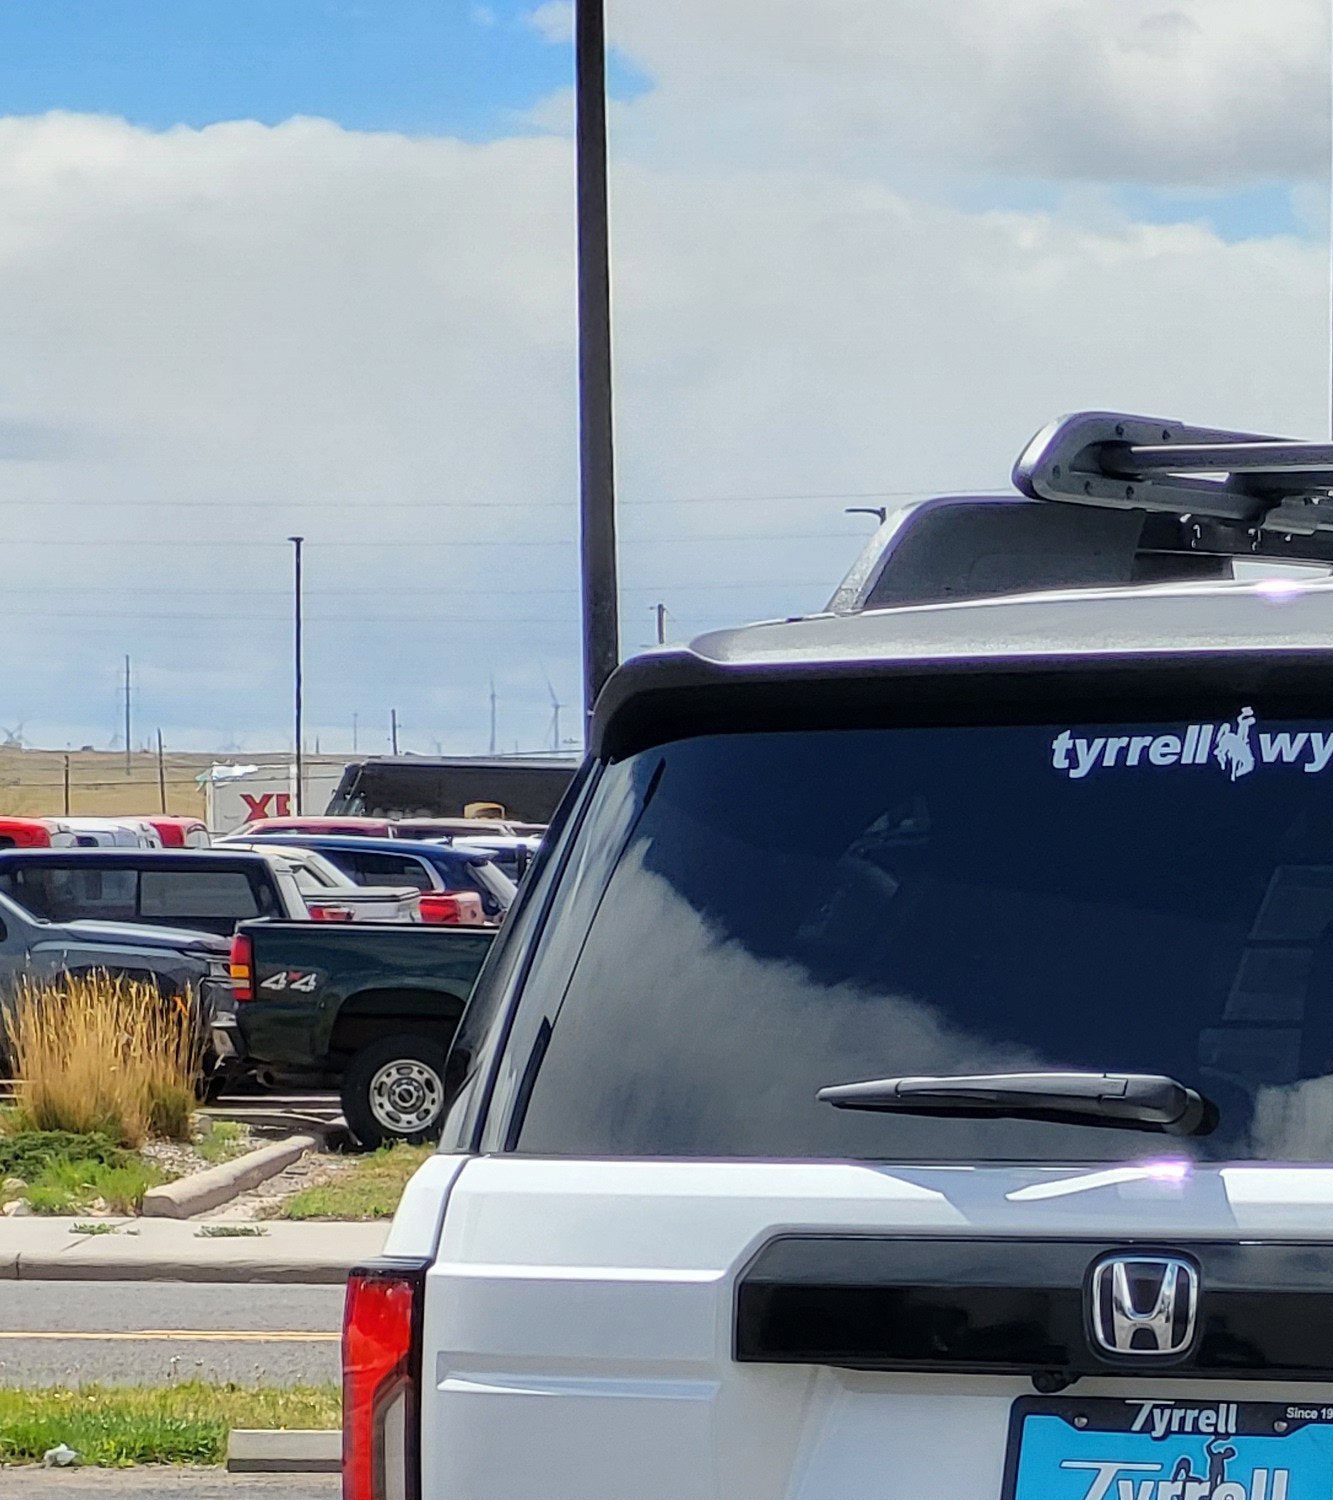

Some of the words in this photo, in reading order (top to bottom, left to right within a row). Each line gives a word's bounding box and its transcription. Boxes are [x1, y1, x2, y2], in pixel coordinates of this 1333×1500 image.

[1052, 724, 1213, 778] tyrrell
[1124, 1400, 1238, 1438] Tyrrell
[1286, 1406, 1318, 1420] Since
